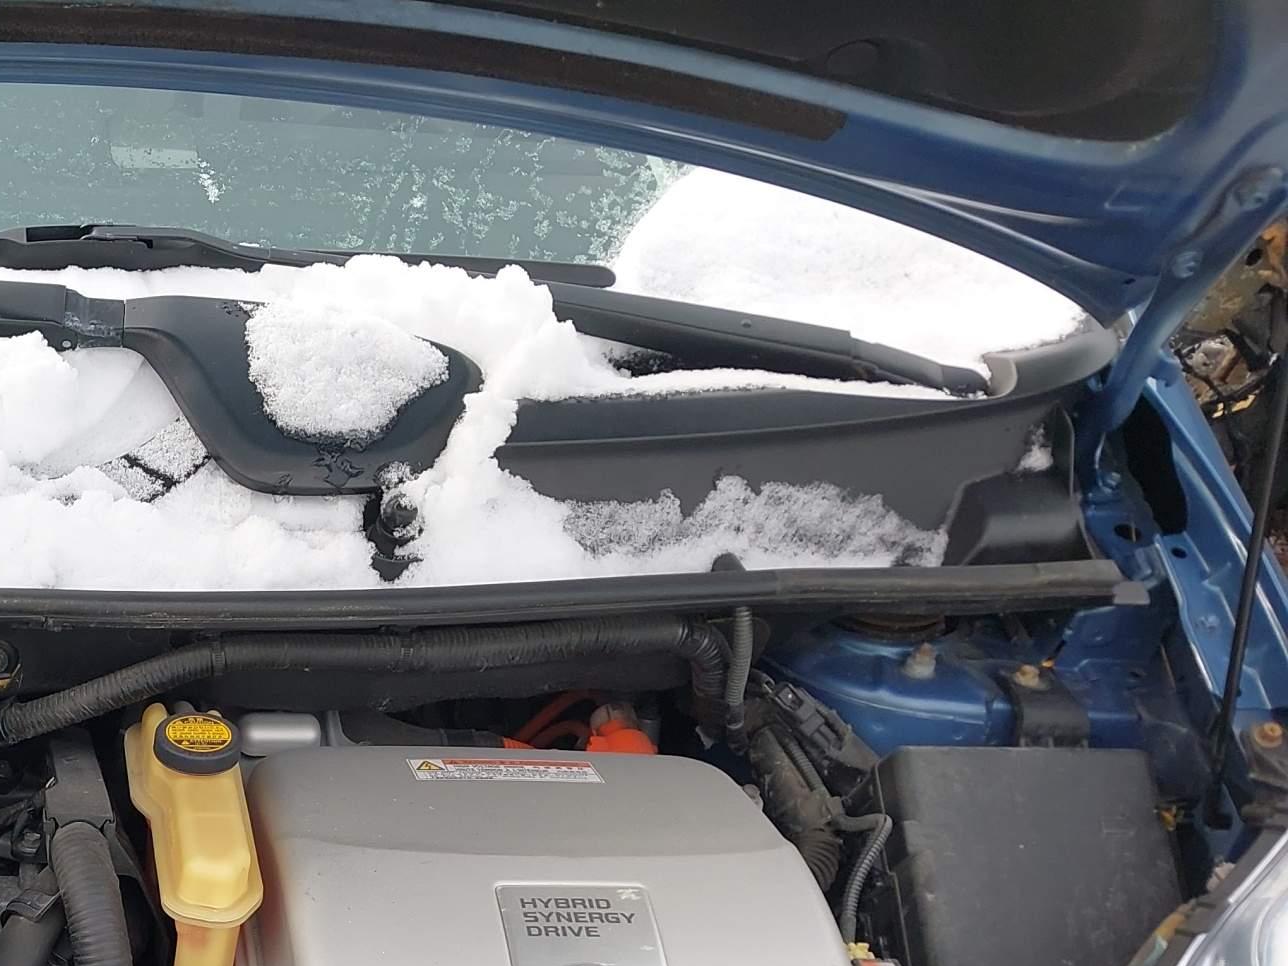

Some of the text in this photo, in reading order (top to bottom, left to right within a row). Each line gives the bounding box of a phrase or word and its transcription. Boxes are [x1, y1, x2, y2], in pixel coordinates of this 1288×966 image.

[520, 898, 611, 910] HYBRID
[523, 911, 635, 924] SYNERGY
[526, 925, 601, 937] DRIVE
